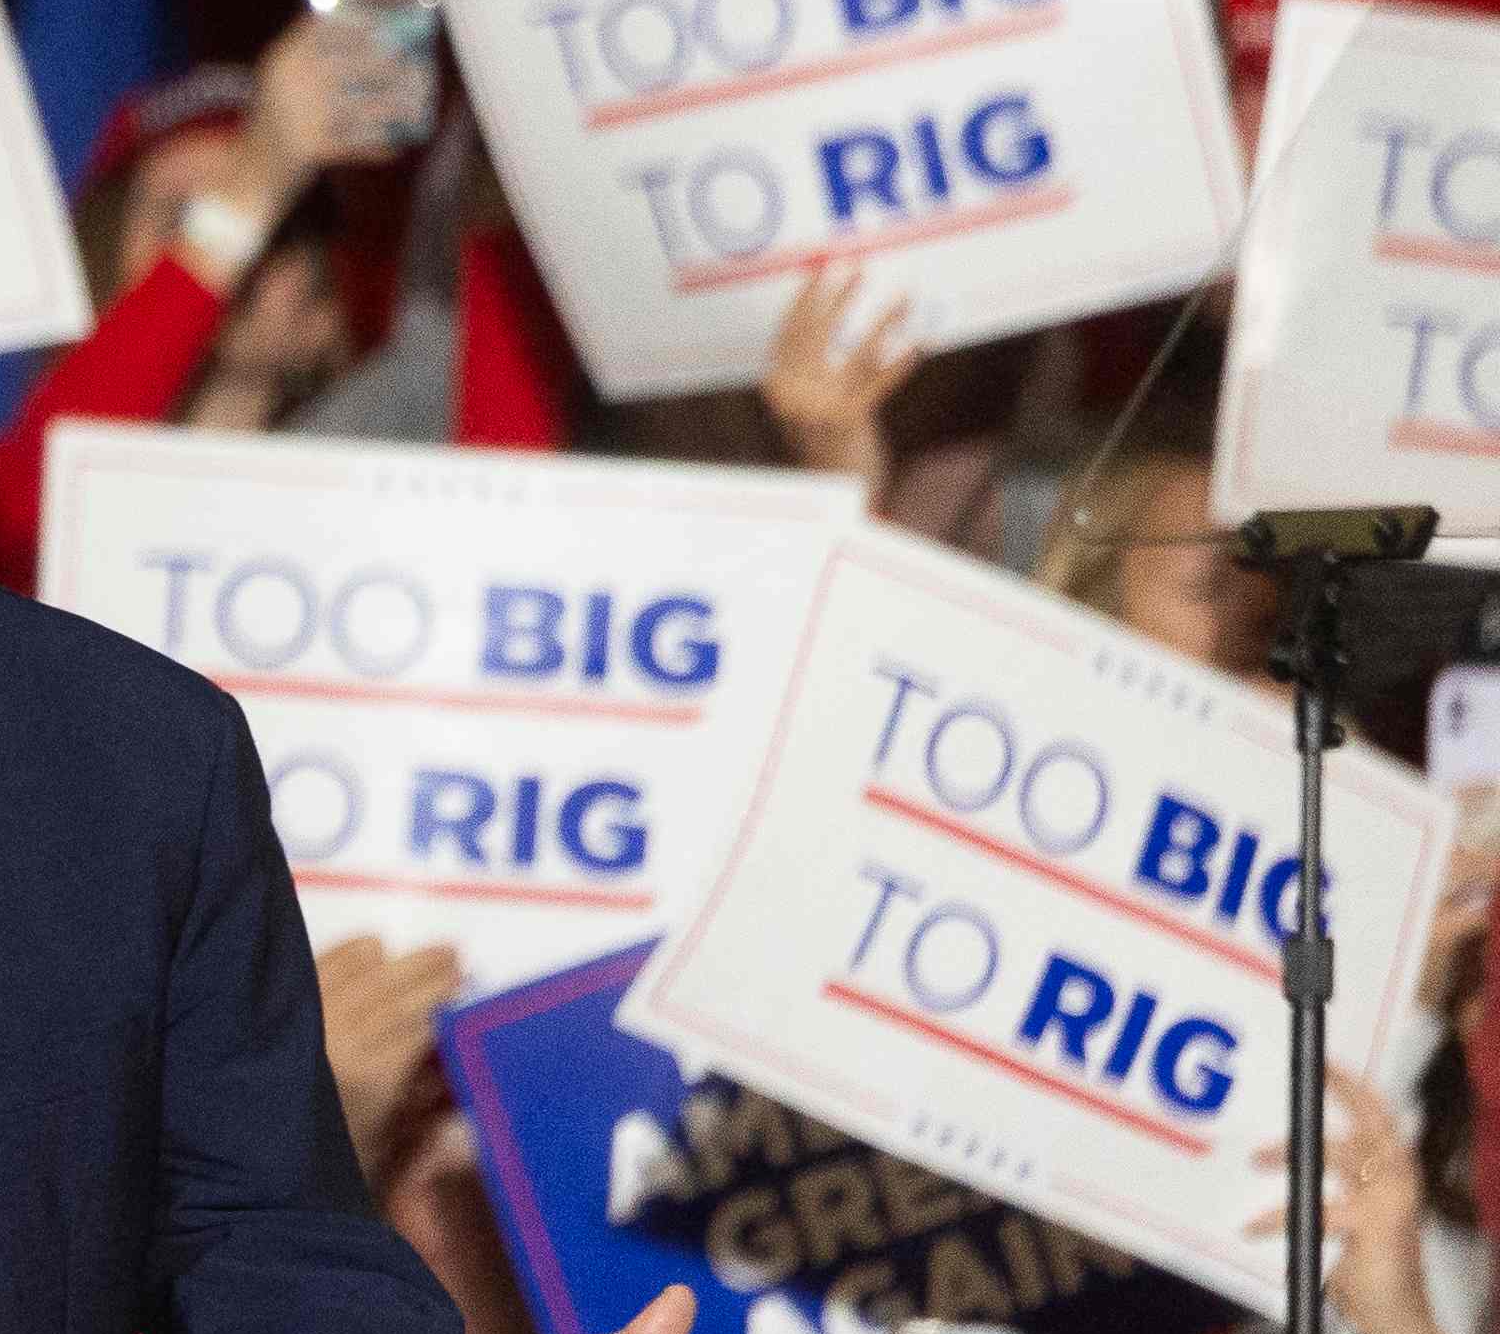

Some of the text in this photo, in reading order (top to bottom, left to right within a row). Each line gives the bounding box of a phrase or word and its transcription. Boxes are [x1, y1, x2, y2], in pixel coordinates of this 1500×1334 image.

[620, 93, 1054, 267] TO RIG
[1357, 104, 1500, 244] TO
[141, 545, 722, 688] TOO BIG
[266, 745, 648, 875] O RIG
[869, 654, 1334, 945] TOO BIG
[850, 862, 1241, 1117] TO RIG
